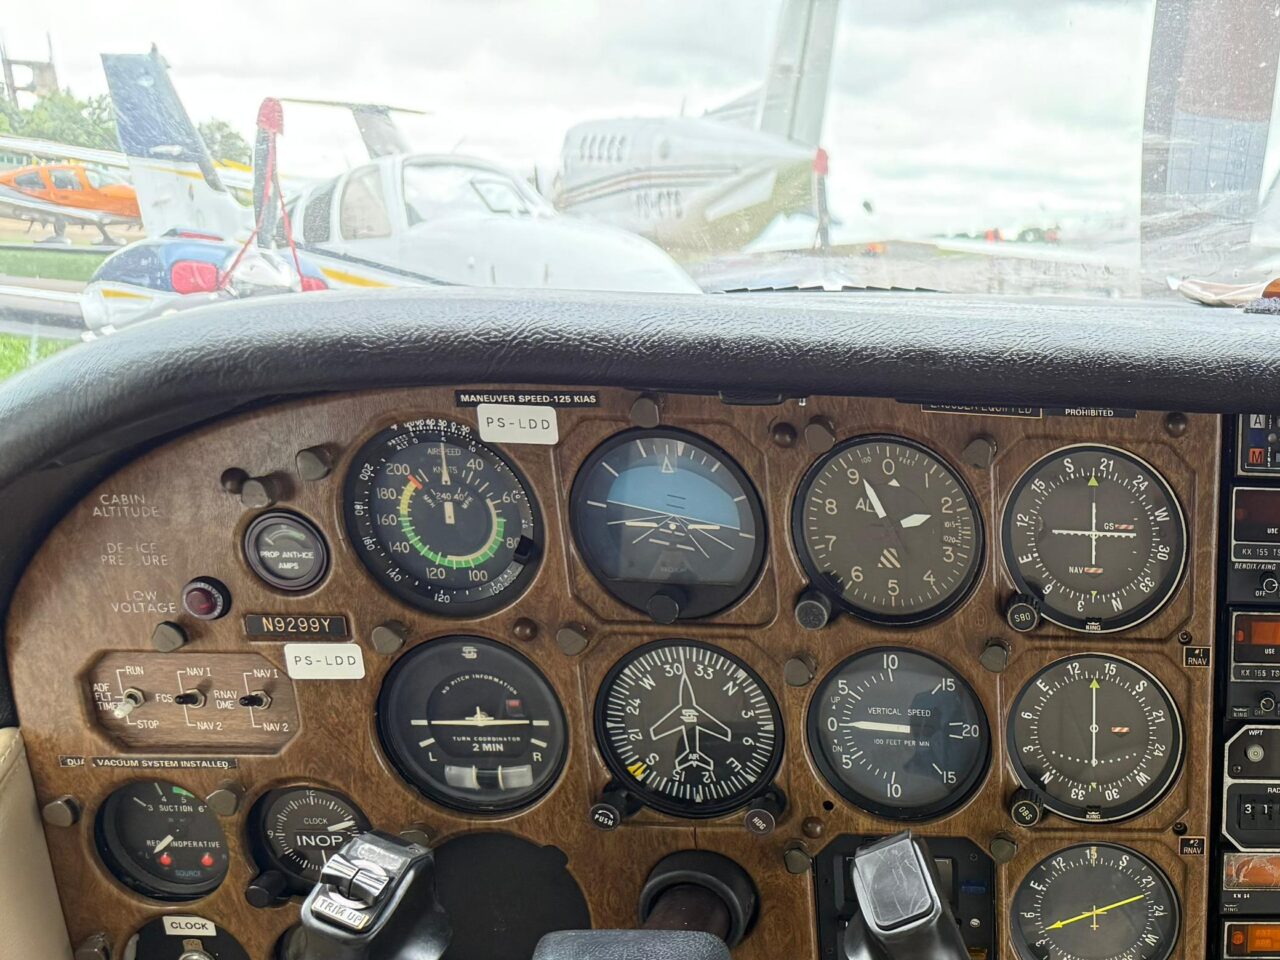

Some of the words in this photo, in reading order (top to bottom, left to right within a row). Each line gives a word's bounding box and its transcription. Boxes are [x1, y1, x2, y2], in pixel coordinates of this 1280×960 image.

[460, 394, 516, 403] MANEUVER
[519, 395, 571, 404] SPEED-125
[573, 395, 597, 404] KIAS
[1065, 408, 1114, 417] PROHIBITED
[486, 417, 551, 430] PS-LDD
[386, 463, 409, 475] 200
[100, 494, 145, 505] CABIN
[93, 507, 160, 518] ALTITUDE
[377, 514, 397, 525] 160
[107, 543, 157, 554] DE-ICE
[260, 551, 279, 559] PROP
[282, 551, 315, 559] ANTI-ICE
[278, 562, 299, 570] AMPS
[426, 568, 445, 579] 120
[126, 591, 157, 601] LOW
[111, 602, 177, 613] VOLTAGE
[262, 617, 330, 633] N9299Y
[294, 656, 356, 666] PS-LDD
[883, 654, 898, 669] 10
[126, 666, 144, 675] RUN
[155, 693, 173, 702] FCS
[214, 690, 238, 699] RNAV
[216, 701, 235, 709] DME
[867, 708, 902, 716] VERTICAL
[907, 709, 931, 717] SPEED
[137, 720, 160, 729] STOP
[962, 724, 979, 737] 20
[159, 804, 193, 812] SUCTION
[1019, 806, 1032, 820] OBS
[170, 840, 220, 848] INOPERATIVE
[297, 835, 343, 847] INOP
[318, 899, 346, 917] TRIM
[347, 911, 363, 924] UP
[170, 920, 208, 931] CLOCK
